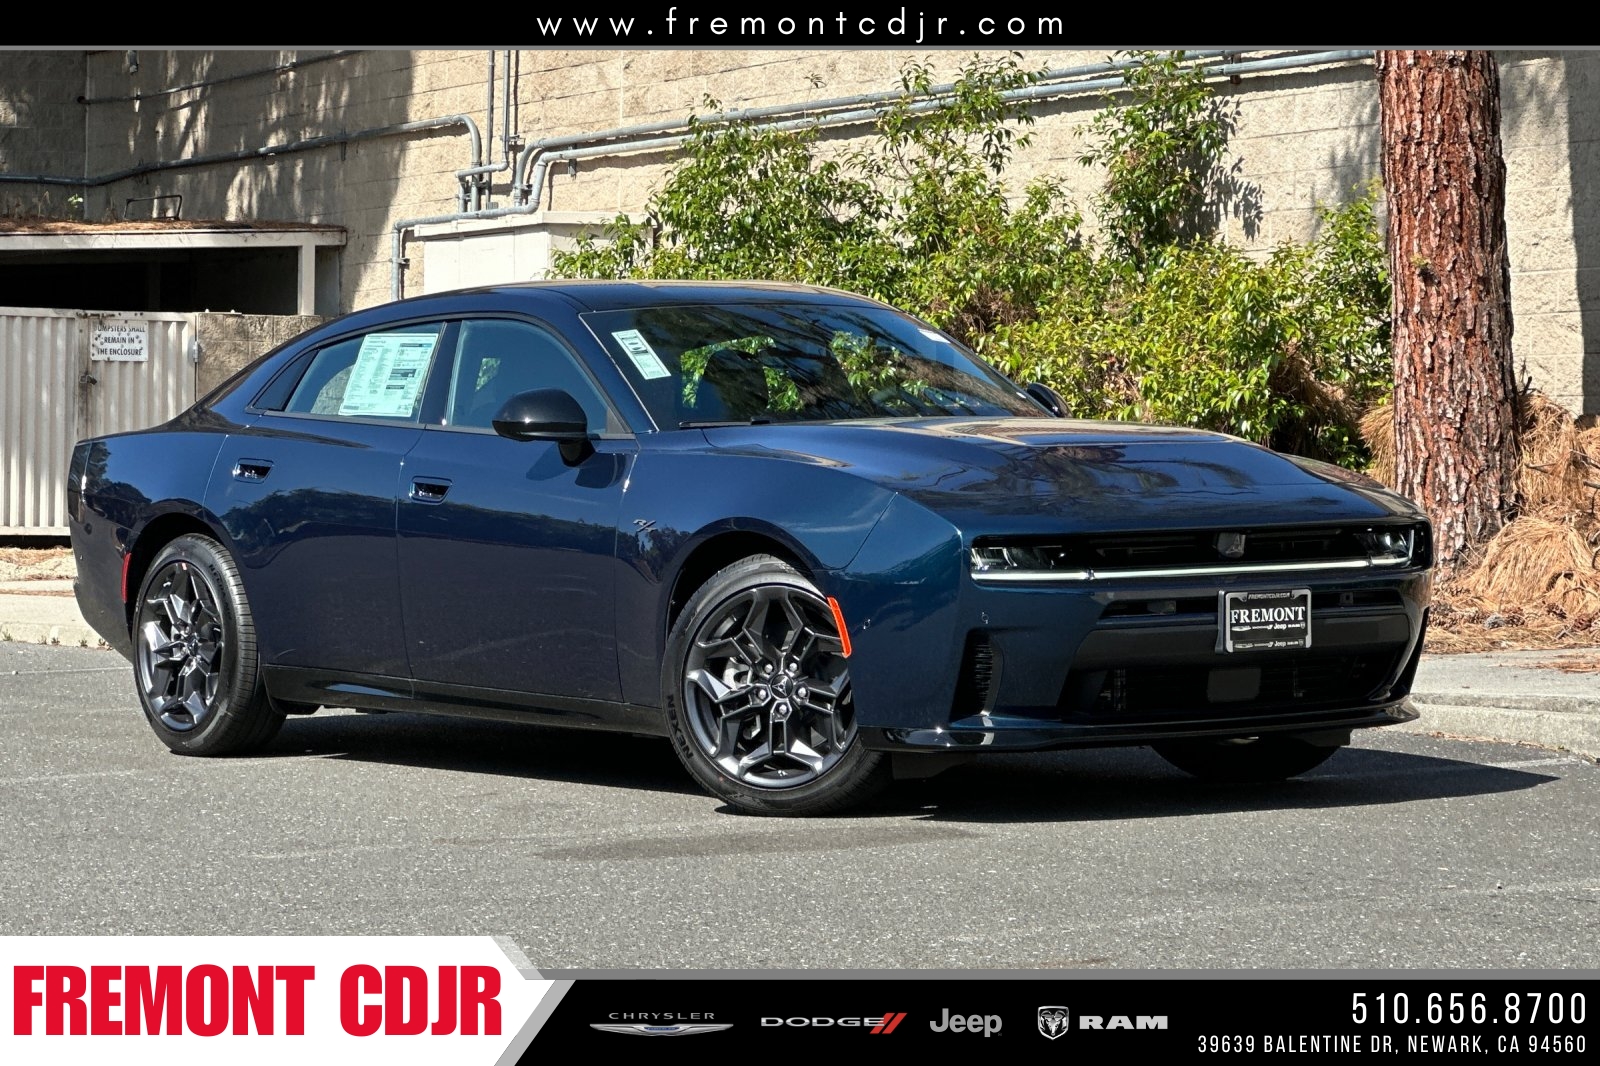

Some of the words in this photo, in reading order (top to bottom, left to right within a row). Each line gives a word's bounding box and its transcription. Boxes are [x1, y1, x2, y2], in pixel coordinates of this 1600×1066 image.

[103, 336, 127, 344] REMAIN
[109, 348, 142, 356] ENCLOSURE
[1230, 606, 1306, 624] FREMONT
[666, 694, 694, 760] NEXEN
